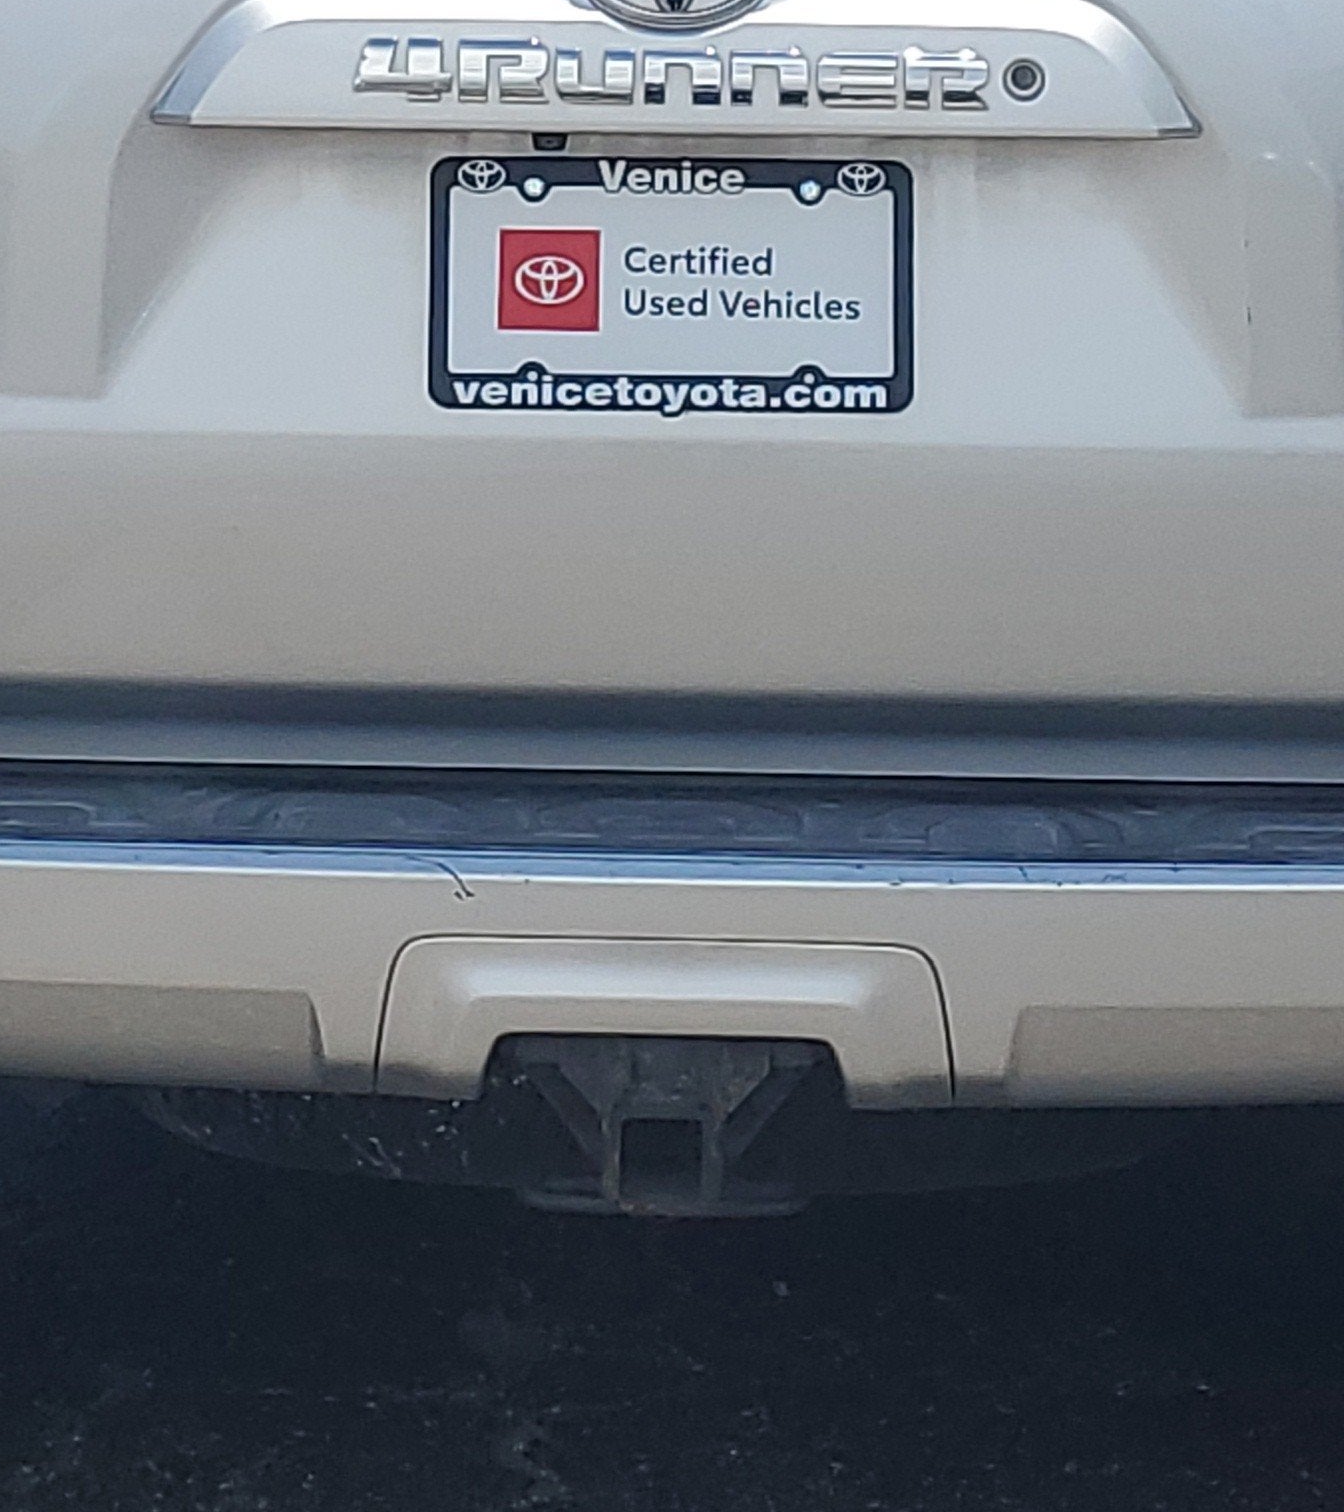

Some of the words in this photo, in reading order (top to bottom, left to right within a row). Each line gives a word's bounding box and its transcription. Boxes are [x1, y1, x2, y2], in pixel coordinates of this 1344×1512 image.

[598, 159, 746, 193] Venice
[623, 245, 773, 276] Certified
[623, 287, 708, 317] Used
[718, 288, 862, 320] Vehicles
[452, 372, 888, 414] venicetoyota.com
